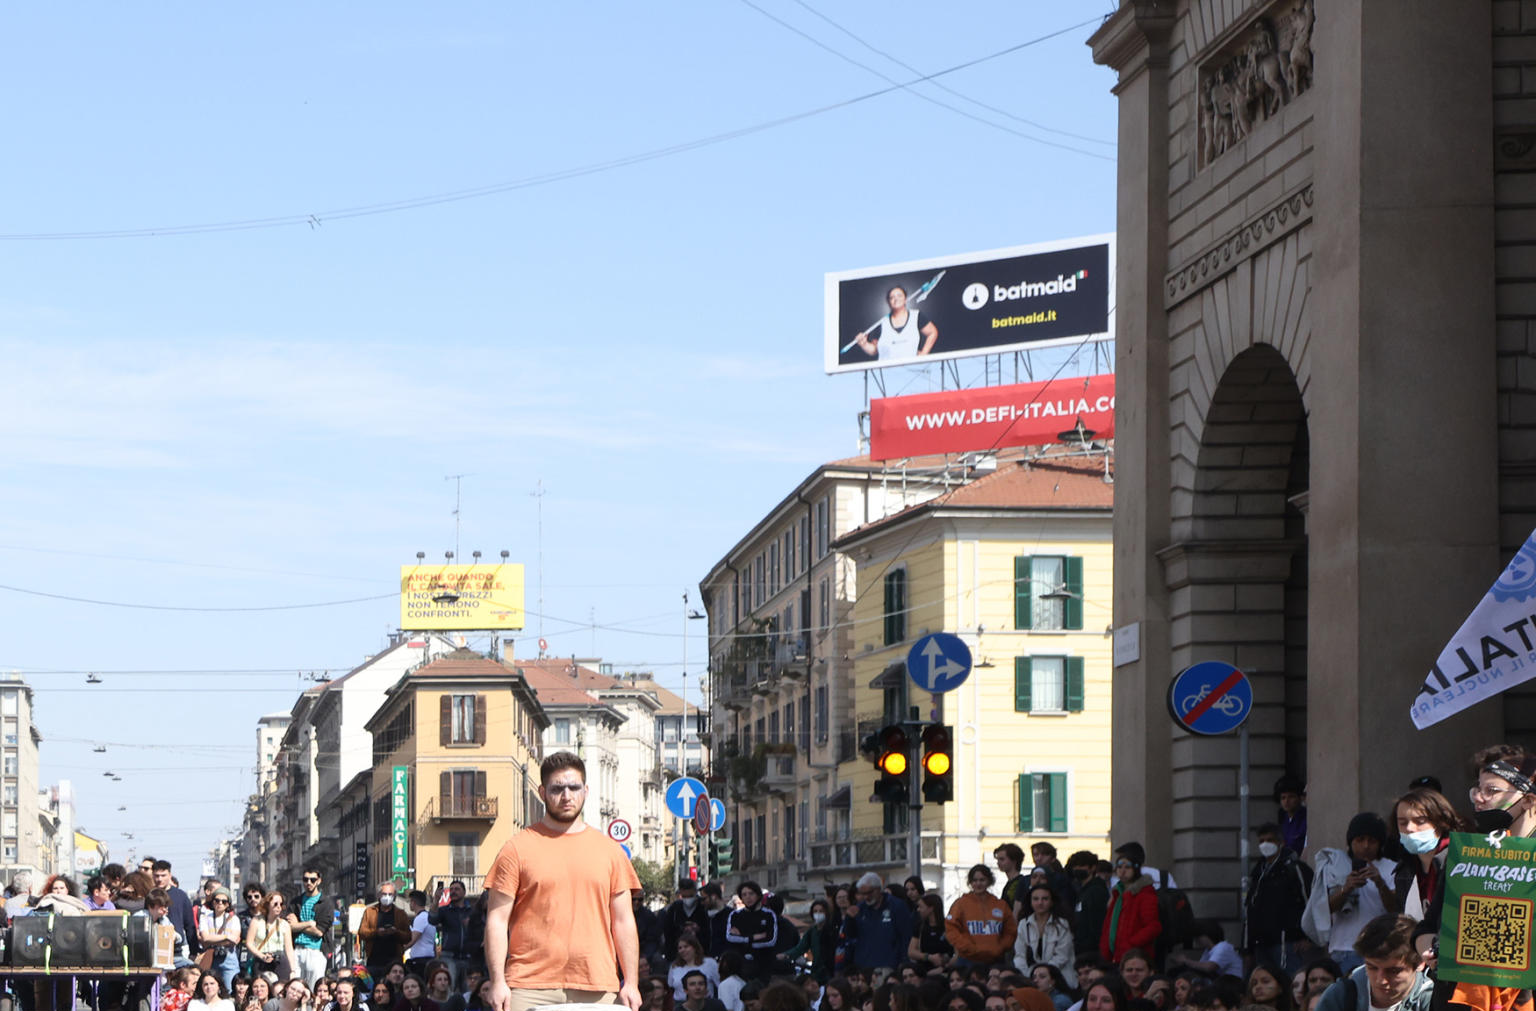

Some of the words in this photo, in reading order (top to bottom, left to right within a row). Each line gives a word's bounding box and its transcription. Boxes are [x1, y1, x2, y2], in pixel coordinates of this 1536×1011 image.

[994, 274, 1076, 302] batmaid
[991, 310, 1057, 328] batmaid.it
[408, 573, 443, 582] ANCHE
[447, 573, 494, 582] QUANDO
[407, 583, 417, 592] IL
[407, 601, 432, 609] NON
[435, 600, 480, 608] TEMONO
[394, 770, 406, 868] FARMACIA
[614, 825, 627, 836] 30
[1461, 846, 1491, 858] FIRMA
[1494, 849, 1531, 861] SUBITO
[1450, 862, 1536, 882] PLANTBASE
